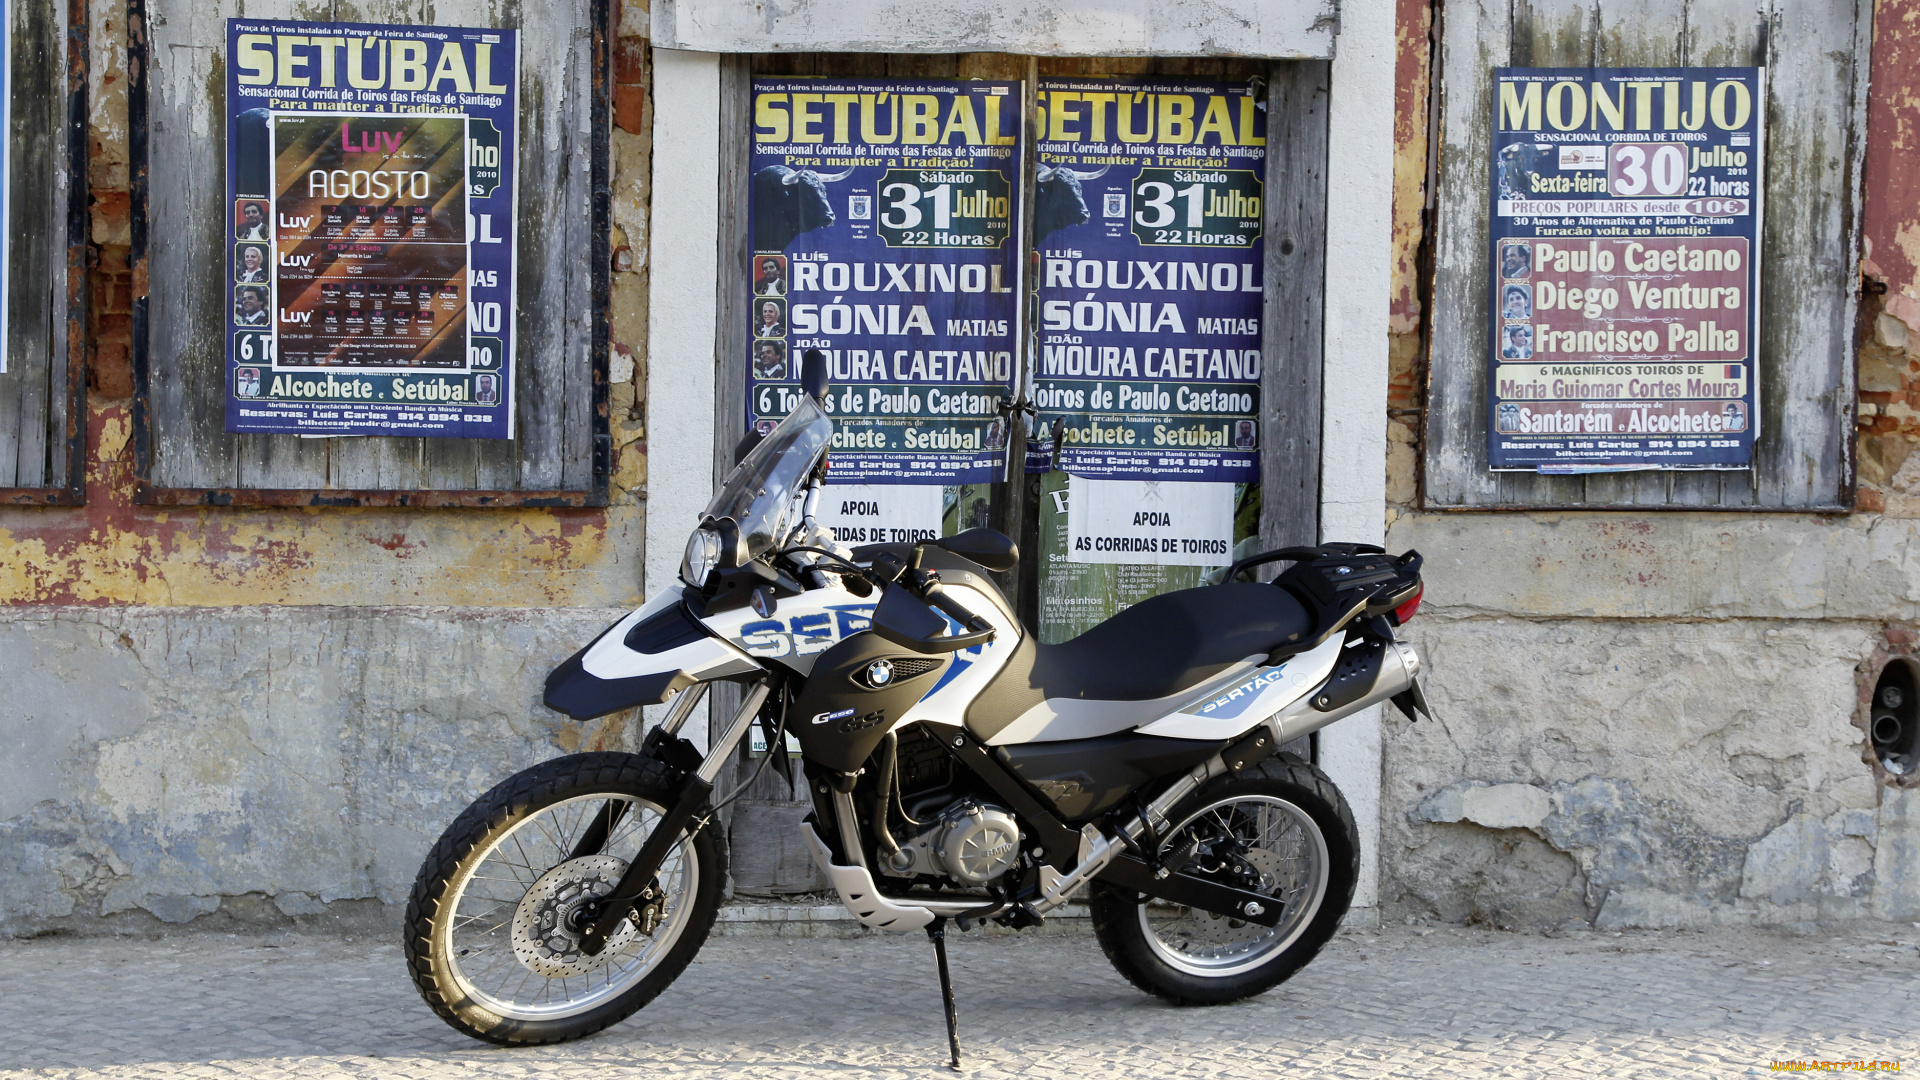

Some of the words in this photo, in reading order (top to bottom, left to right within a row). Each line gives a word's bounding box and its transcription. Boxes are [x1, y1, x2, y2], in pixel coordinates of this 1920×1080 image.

[236, 24, 254, 32] Praça
[345, 28, 370, 37] Parque
[416, 31, 447, 40] Santiago
[237, 34, 507, 94] SETÚBAL
[238, 85, 298, 98] Sensacional
[302, 87, 338, 99] Corrida
[342, 88, 353, 100] de
[356, 90, 387, 101] Toiros
[391, 91, 408, 102] das
[412, 92, 441, 103] Festas
[445, 92, 456, 104] de
[459, 93, 502, 107] Santiago
[1500, 81, 1751, 130] MONTIJO
[269, 99, 309, 109] Para
[313, 101, 370, 112] manter
[390, 103, 464, 114] Tradição!
[755, 92, 1016, 145] SETÚBAL
[1037, 91, 1266, 146] ETÚBAL
[342, 123, 403, 152] Luv
[1534, 133, 1602, 142] SENSACIONAL
[1605, 133, 1650, 142] CORRIDA
[1653, 133, 1666, 142] DE
[1669, 133, 1707, 141] TOIROS
[920, 171, 973, 184] Sábado
[1174, 170, 1227, 183] Sábado
[1614, 146, 1684, 195] 30
[1689, 145, 1747, 173] Julho
[309, 170, 429, 199] AGOSTO
[1531, 172, 1607, 193] Sexta-feira
[1689, 177, 1706, 196] 22
[1710, 176, 1749, 196] horas
[880, 183, 950, 229] 31
[952, 190, 1007, 218] Julho
[1135, 182, 1204, 228] 31
[1205, 189, 1259, 217] Julho
[1512, 202, 1560, 216] PREÇOS
[1567, 202, 1638, 213] POPULARES
[1644, 202, 1680, 213] desde
[1692, 200, 1738, 212] 10€
[280, 213, 310, 228] Luv
[1514, 217, 1528, 225] 30
[1532, 217, 1558, 225] Anos
[1562, 217, 1575, 225] de
[1578, 217, 1635, 225] Alternativa
[1639, 217, 1652, 225] de
[1656, 216, 1686, 225] Paulo
[1689, 216, 1734, 225] Caetano
[902, 232, 929, 244] 22
[935, 232, 994, 246] Horas
[1155, 230, 1181, 243] 22
[1187, 230, 1247, 245] Horas
[1536, 226, 1592, 236] Furacão
[1596, 226, 1631, 235] volta
[1655, 226, 1711, 237] Montijo!
[280, 252, 310, 266] Luv
[793, 251, 828, 261] LUÍS
[1046, 248, 1082, 258] LUÍS
[1535, 241, 1615, 271] Paulo
[1624, 243, 1741, 271] Caetano
[793, 262, 1011, 293] ROUXINOL
[1046, 259, 1263, 292] ROUXINOL
[1536, 281, 1619, 318] Diego
[1628, 281, 1740, 309] Ventura
[281, 308, 310, 322] Luv
[792, 296, 935, 335] SÓNIA
[947, 319, 1007, 336] MATIAS
[1044, 293, 1186, 333] SÓNIA
[1198, 318, 1258, 335] MATIAS
[793, 338, 830, 348] JOÃO
[1044, 334, 1082, 344] JOÃO
[1536, 323, 1659, 353] Francisco
[1668, 321, 1739, 352] Palha
[894, 351, 1011, 382] CAETANO
[1043, 346, 1138, 377] MOURA
[1144, 348, 1261, 379] CAETANO
[1540, 367, 1547, 375] 6
[1552, 364, 1632, 375] MAGNÍFICOS
[1637, 365, 1683, 375] TOIROS
[1688, 365, 1704, 375] DE
[270, 375, 372, 399] Alcochete
[392, 378, 469, 401] Setúbal
[1091, 383, 1112, 409] de
[1119, 384, 1170, 410] Paulo
[1177, 386, 1252, 412] Caetano
[1501, 380, 1546, 398] Maria
[1553, 379, 1623, 398] Guiomar
[1629, 379, 1681, 398] Cortes
[1687, 378, 1739, 397] Moura
[760, 387, 771, 412] 6
[841, 387, 863, 413] de
[869, 388, 922, 414] Paulo
[240, 409, 307, 418] Reservas:
[1519, 407, 1612, 432] Santarém
[1628, 408, 1721, 432] Alcochete
[298, 420, 444, 428] bilhetesaplaudir@gmail.com
[904, 428, 980, 449] Setúbal
[1153, 425, 1229, 446] Setúbal
[1062, 465, 1204, 473] bilhetesaplaudir@gmail.com
[841, 501, 879, 516] APOIA
[1133, 512, 1170, 526] APOIA
[870, 528, 886, 542] DE
[890, 528, 936, 543] TOIROS
[1076, 537, 1091, 550] AS
[1095, 538, 1157, 552] CORRIDAS
[1162, 539, 1177, 553] DE
[1182, 539, 1227, 554] TOIROS
[986, 844, 1012, 857] BMW
